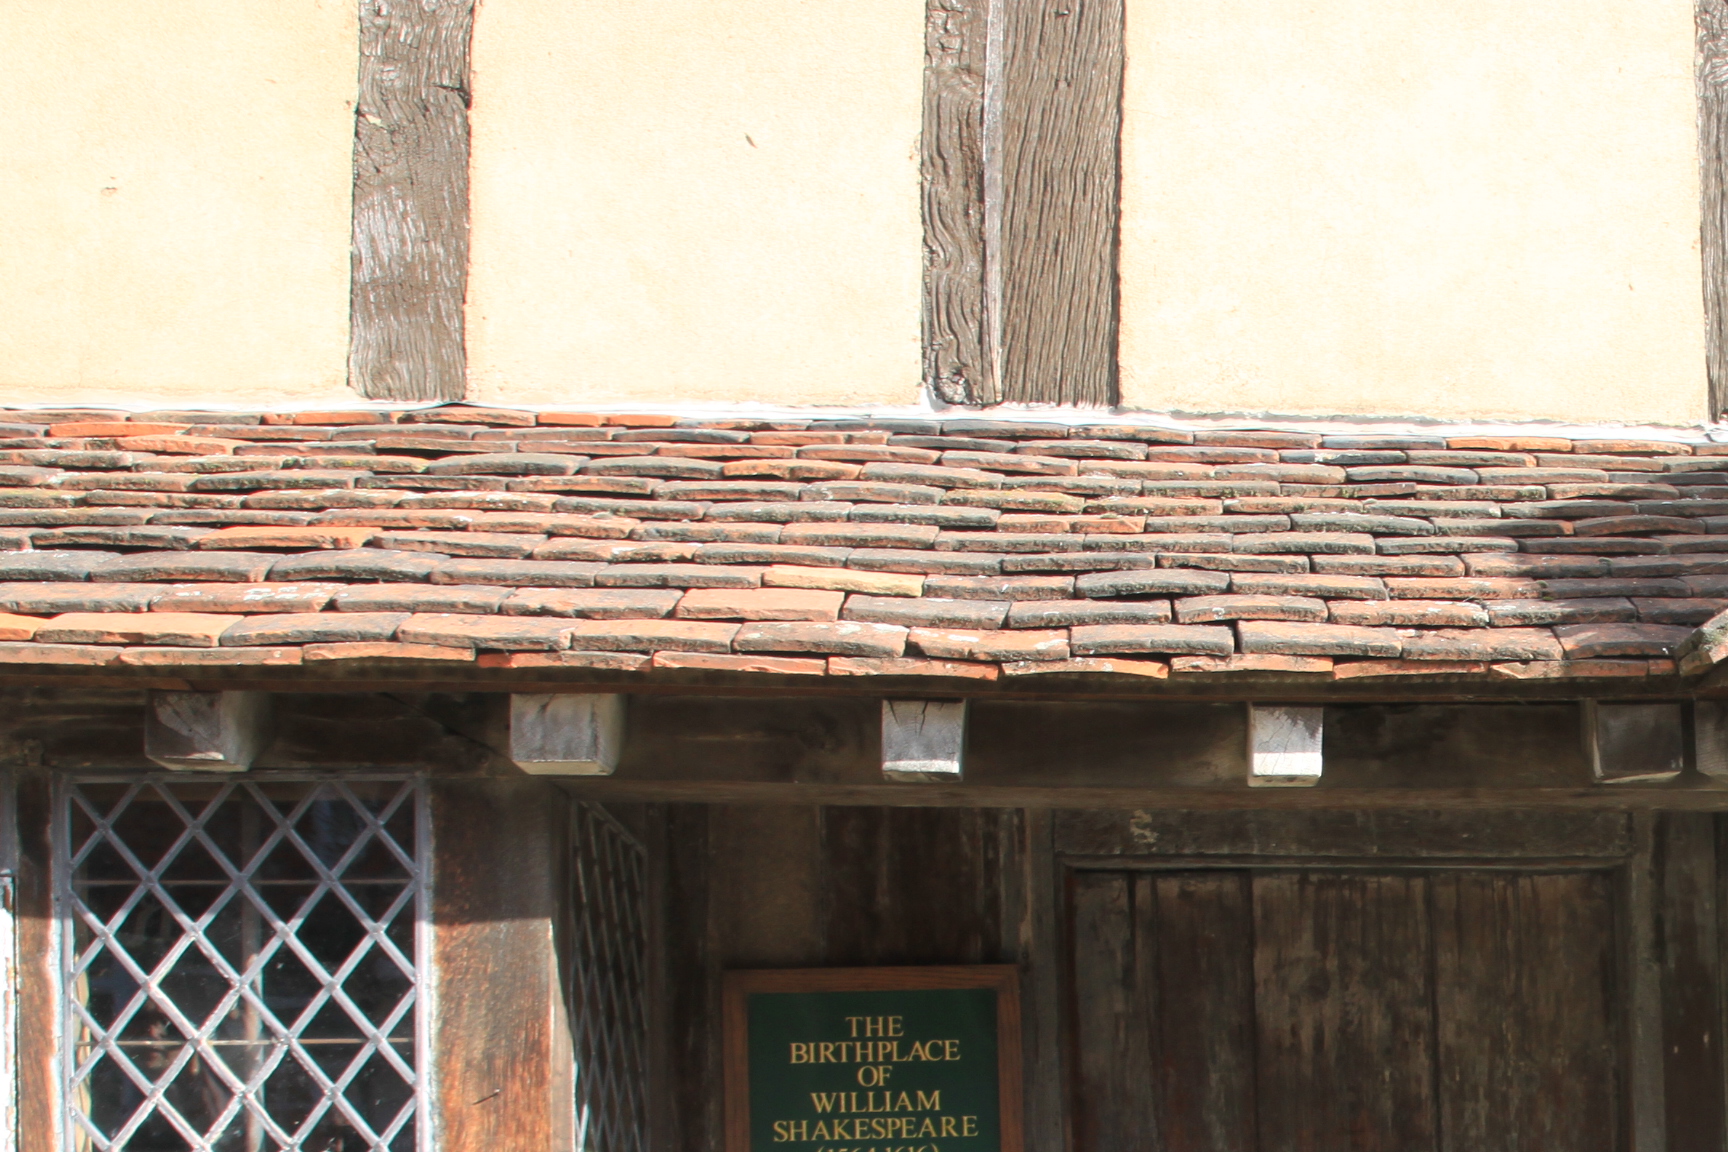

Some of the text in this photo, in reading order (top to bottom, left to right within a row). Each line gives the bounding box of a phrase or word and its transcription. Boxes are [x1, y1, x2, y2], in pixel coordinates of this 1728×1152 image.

[846, 1016, 904, 1038] THE
[790, 1040, 961, 1064] BIRTHPLACE
[857, 1065, 893, 1087] OF
[811, 1090, 941, 1113] WILLIAM
[773, 1115, 978, 1142] SHAKESPEARE
